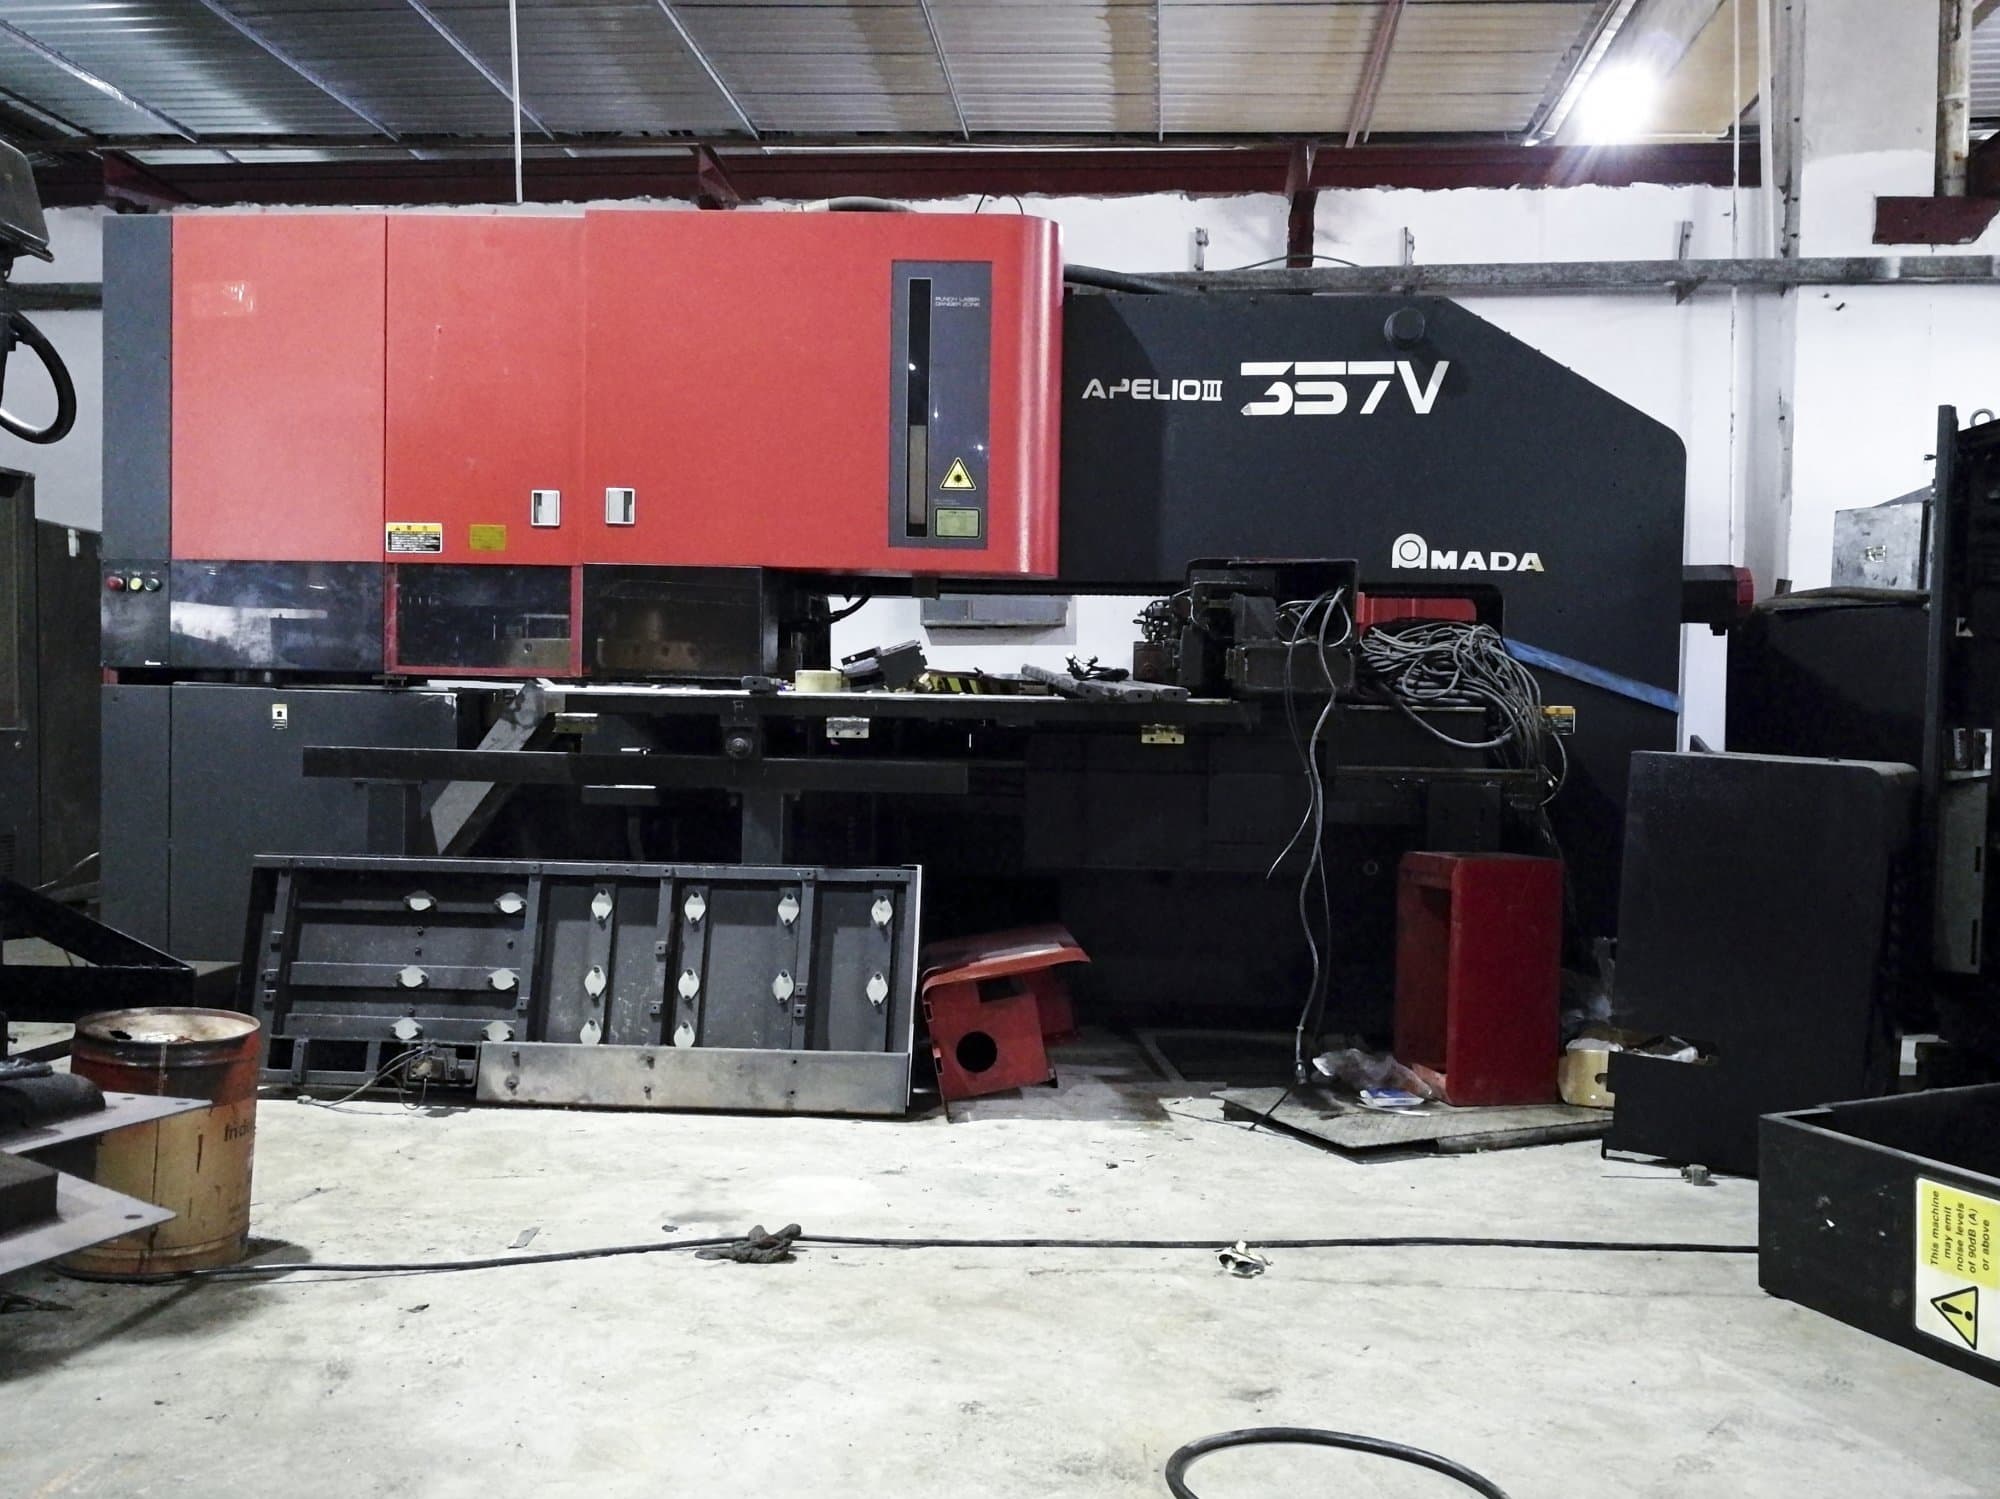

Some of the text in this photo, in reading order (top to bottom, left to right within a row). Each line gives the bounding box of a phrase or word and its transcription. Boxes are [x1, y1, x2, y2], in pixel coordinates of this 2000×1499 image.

[1240, 360, 1450, 415] 357V
[1930, 1190, 1940, 1265] This machine
[1944, 1206, 1954, 1259] may emit
[1955, 1202, 1965, 1271] noise levels
[1967, 1208, 1978, 1274] of 90dB (A)
[1981, 1219, 1990, 1271] or above
